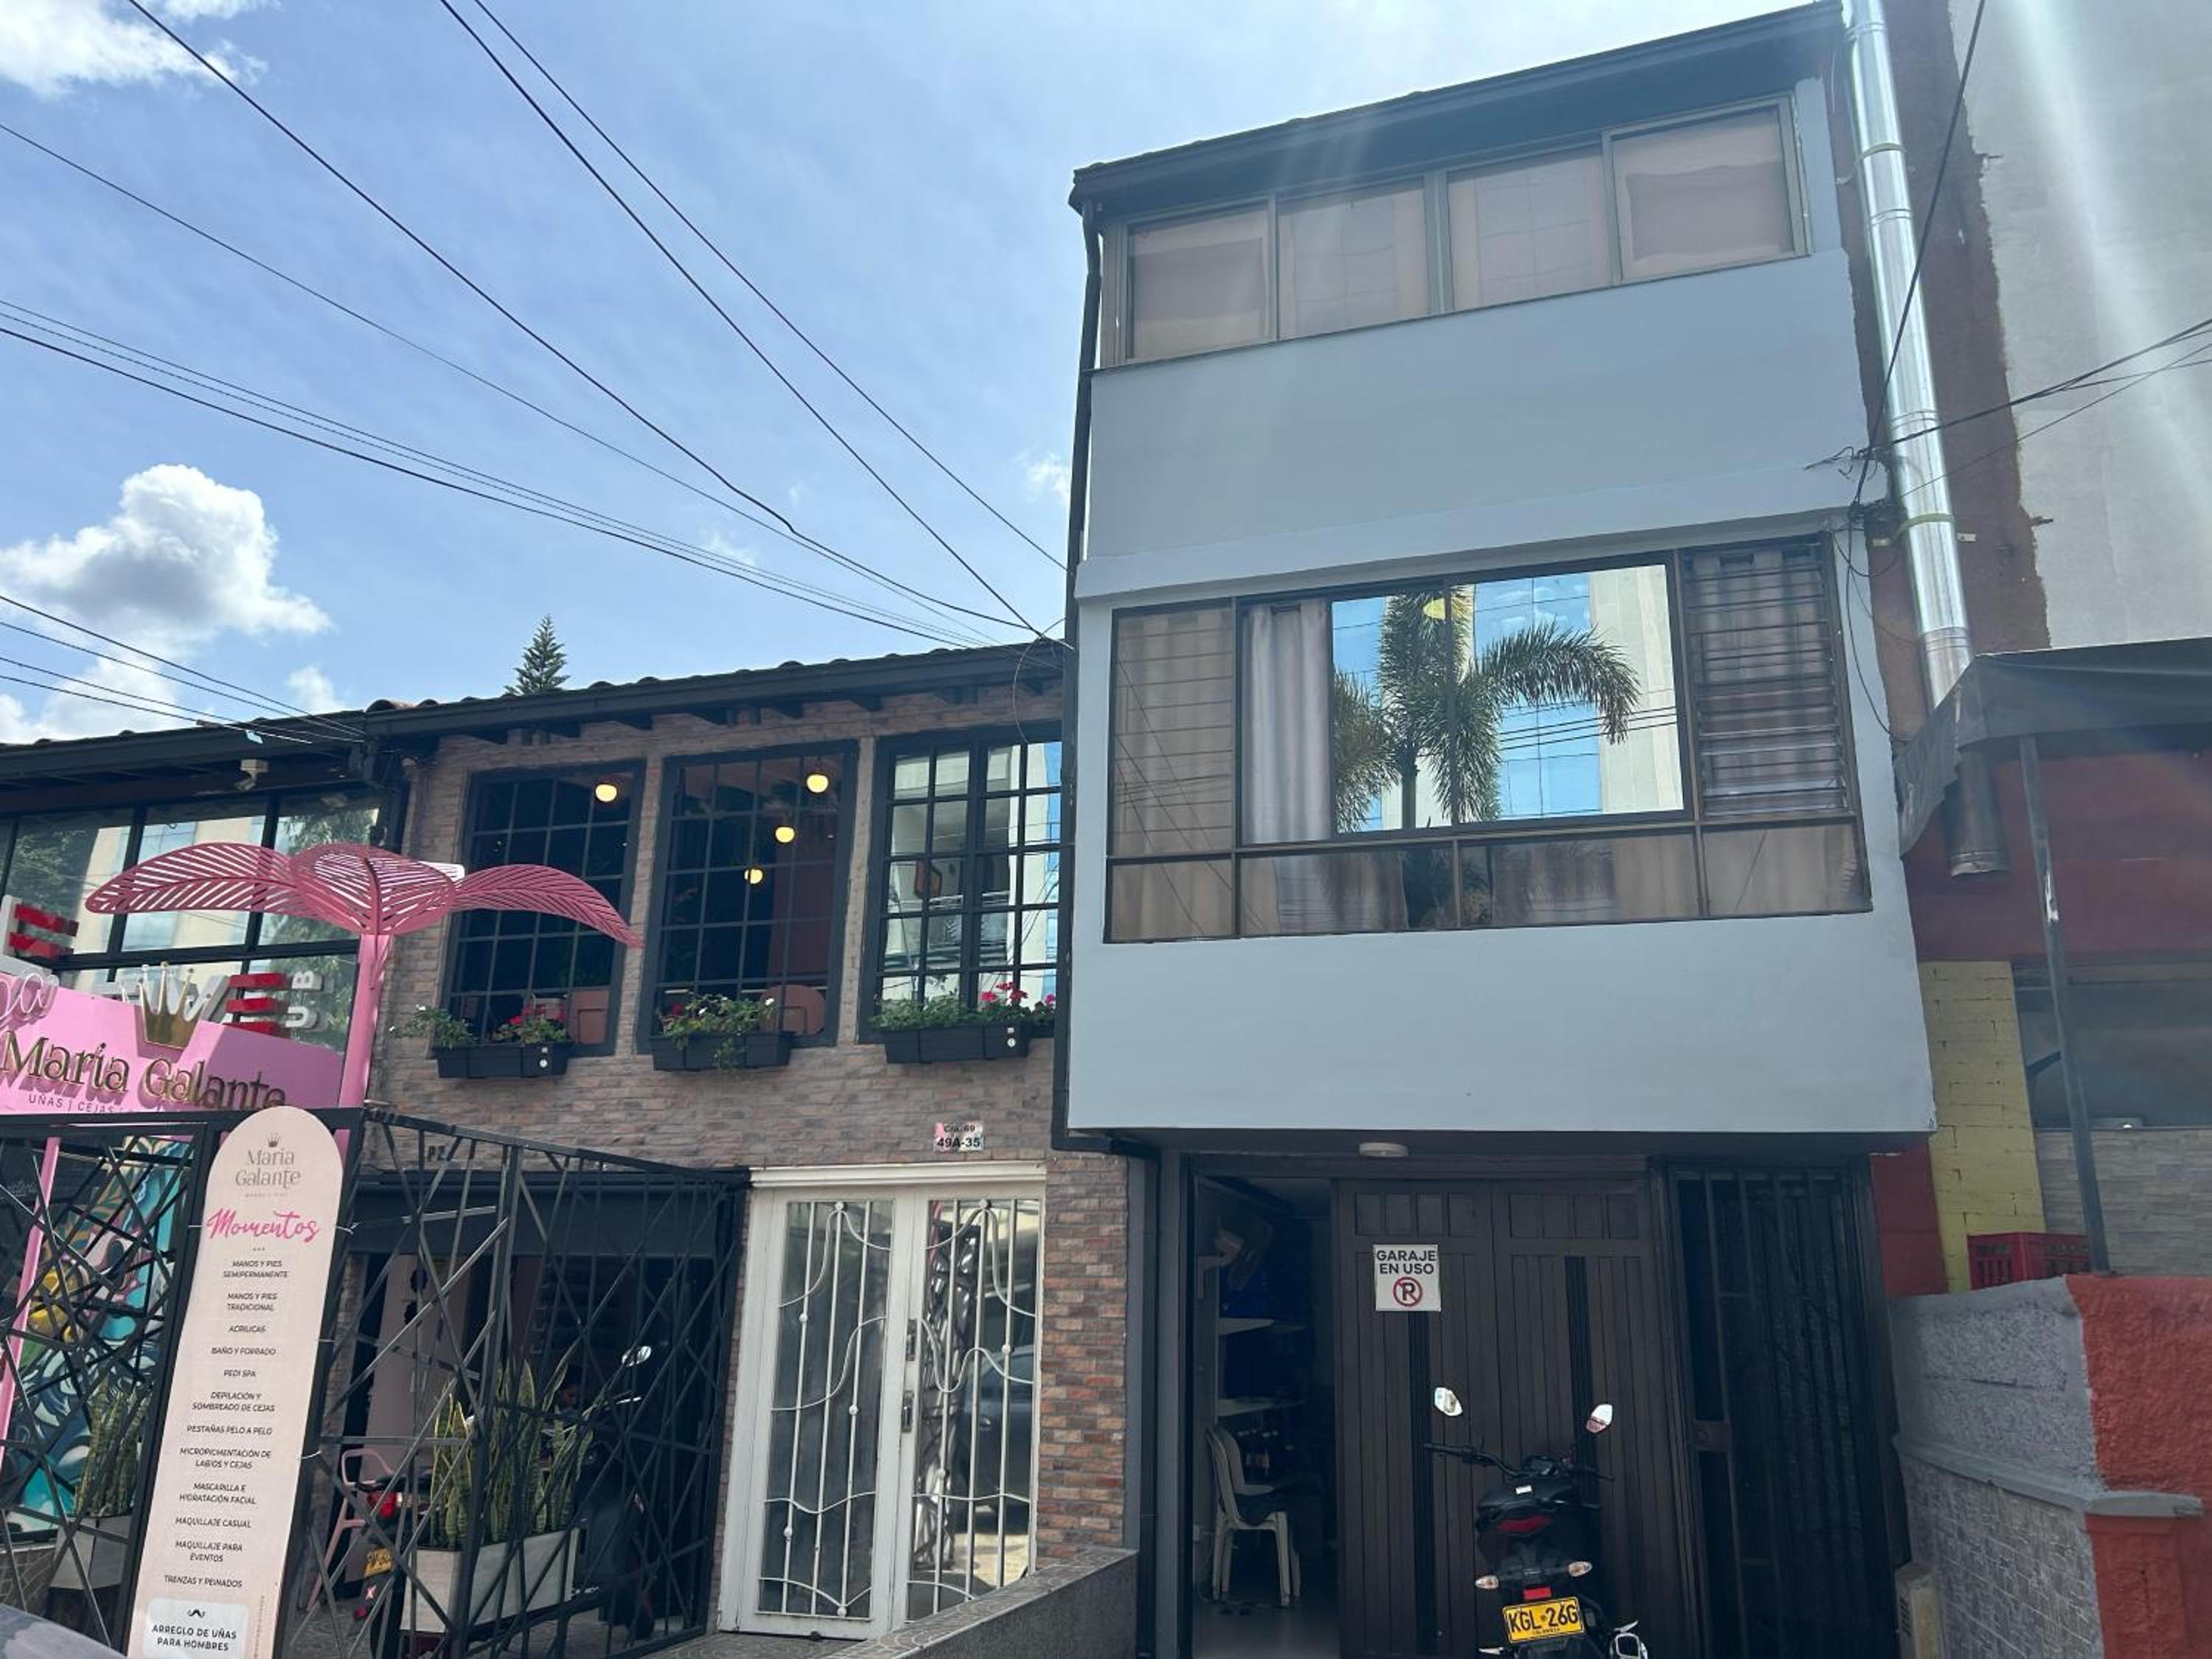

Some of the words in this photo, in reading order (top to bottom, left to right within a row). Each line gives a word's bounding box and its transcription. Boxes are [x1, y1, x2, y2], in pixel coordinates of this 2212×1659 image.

[0, 1031, 131, 1093] Maria
[29, 1093, 64, 1108] UÑAS
[937, 1137, 981, 1148] 49A-35
[247, 1149, 295, 1166] Maria
[235, 1168, 302, 1189] Galante
[206, 1208, 319, 1243] Momentos
[1377, 1250, 1436, 1262] GARAJE
[1380, 1263, 1399, 1274] EN
[1403, 1263, 1434, 1274] USO
[223, 1270, 289, 1279] SEMIPERMANENTE
[226, 1303, 275, 1312] TRADICIONAL
[211, 1347, 233, 1355] BAÑO
[240, 1348, 276, 1356] FORRADO
[211, 1391, 254, 1400] DEPILACIÓN
[192, 1402, 240, 1411] SOMBREADO
[241, 1404, 251, 1412] DE
[252, 1405, 276, 1413] CEJAS
[187, 1425, 225, 1433] PESTAÑAS
[226, 1426, 246, 1434] PELO
[253, 1427, 273, 1435] PELO
[260, 1450, 272, 1458] DE
[229, 1461, 253, 1469] CEJAS
[193, 1483, 240, 1492] MASCARILLA
[179, 1494, 229, 1503] HIDRATACIÓN
[230, 1496, 257, 1505] FACIAL
[175, 1517, 222, 1527] MAQUILLAJE
[223, 1520, 251, 1528] CASUAL
[175, 1540, 222, 1551] MAQUILLAJE
[223, 1543, 243, 1551] PARA
[189, 1553, 223, 1562] EVENTOS
[164, 1575, 197, 1585] TRENZAS
[204, 1577, 243, 1587] PEINADOS
[1508, 1610, 1542, 1632] KGL
[1545, 1604, 1579, 1627] 26G
[152, 1624, 194, 1636] ARREGLO
[196, 1628, 209, 1638] DE
[212, 1628, 237, 1640] UÑAS
[157, 1637, 181, 1646] PARA
[184, 1639, 229, 1651] HOMBRES
